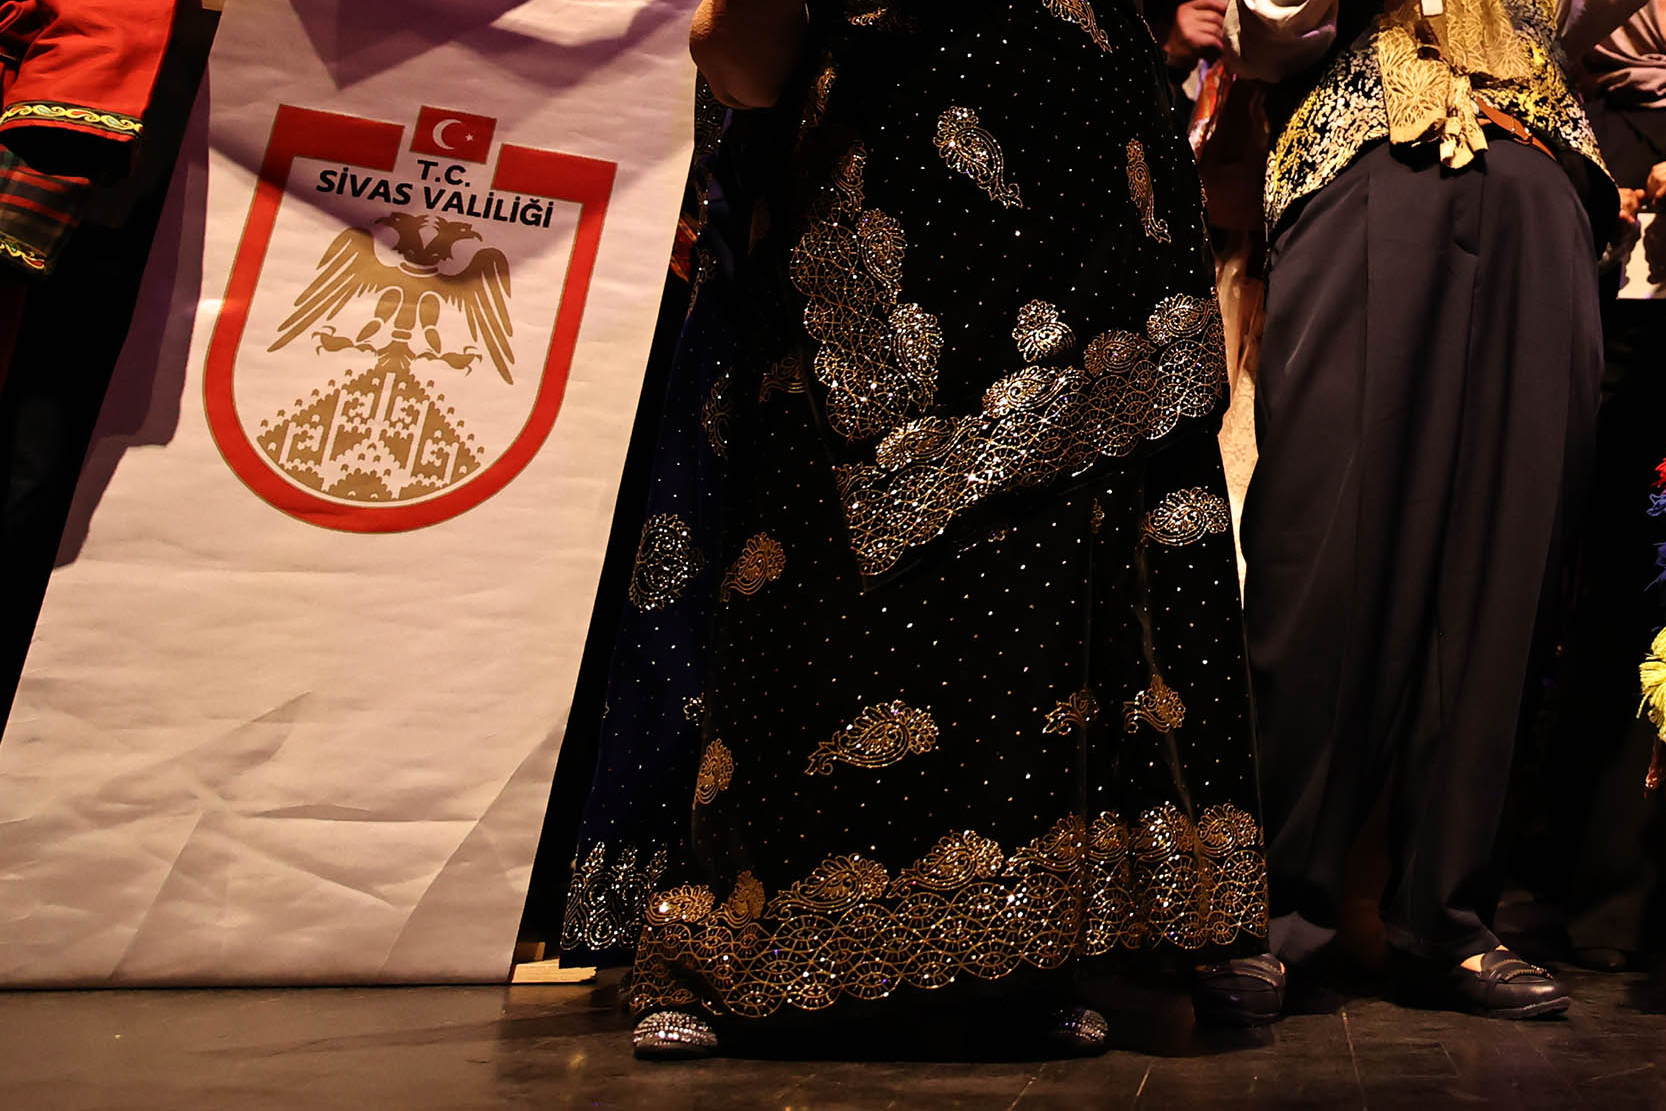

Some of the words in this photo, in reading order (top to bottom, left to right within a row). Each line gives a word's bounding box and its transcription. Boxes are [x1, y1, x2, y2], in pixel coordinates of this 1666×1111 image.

[417, 159, 471, 187] T.C.
[316, 167, 413, 206] SİVAS
[424, 186, 554, 229] VALİLİĞİ
